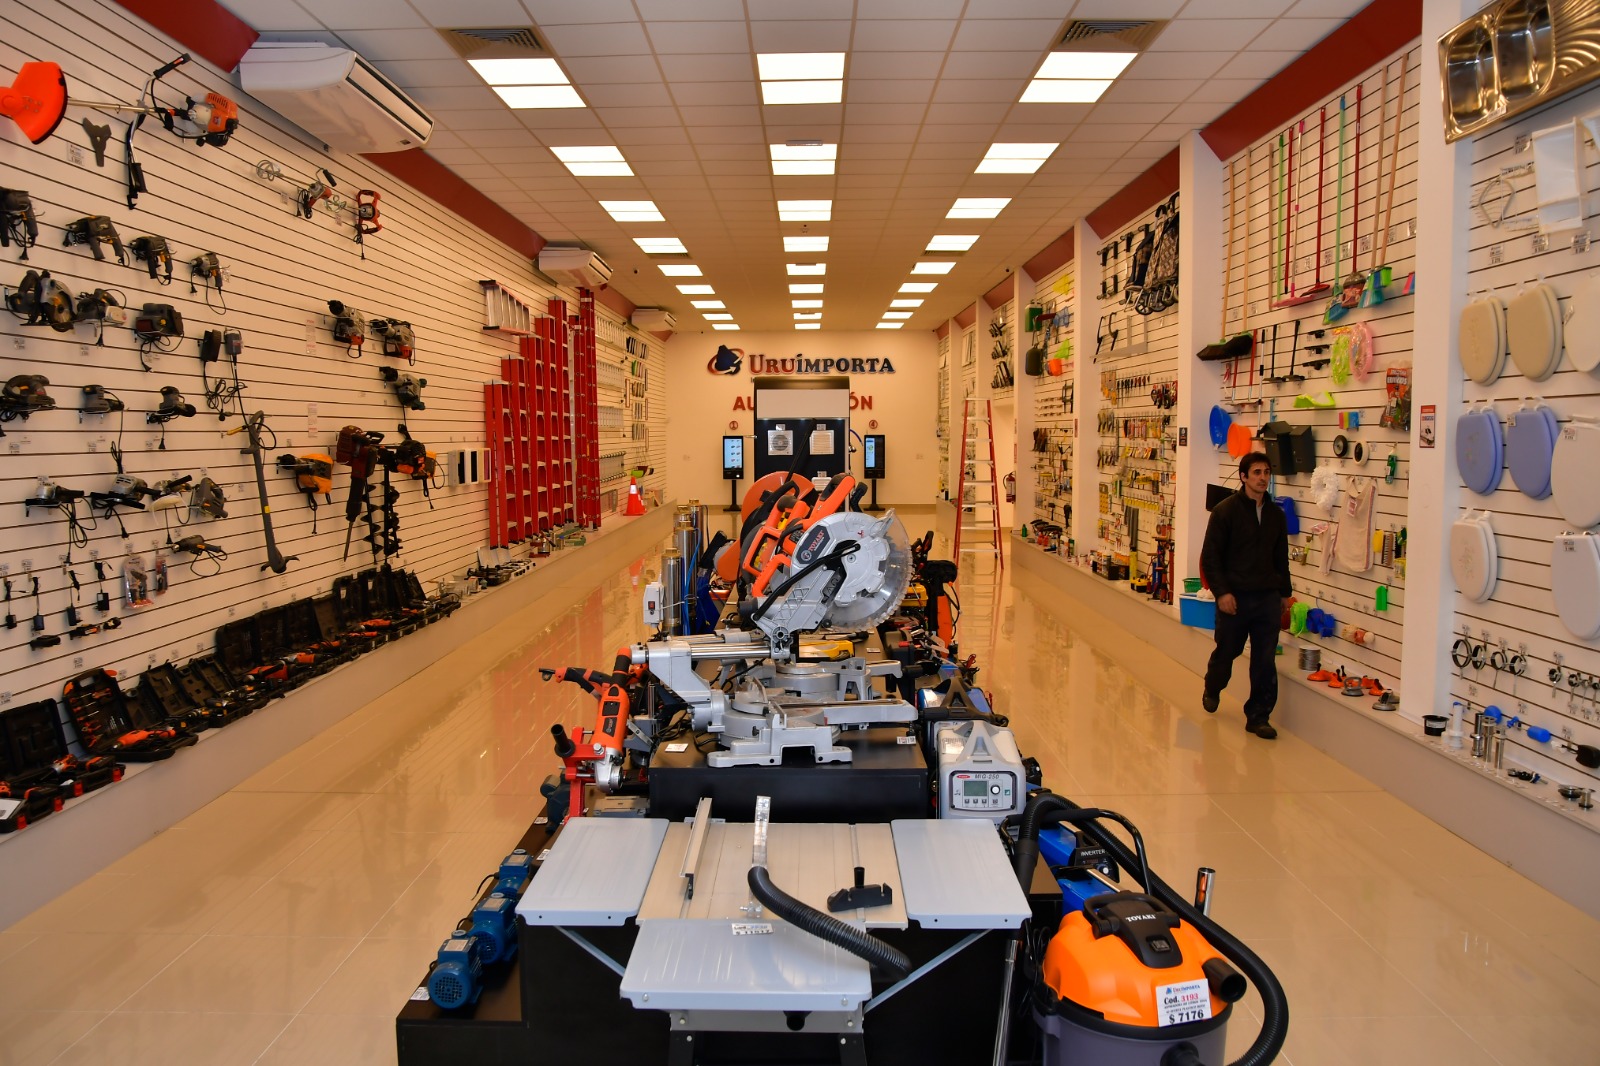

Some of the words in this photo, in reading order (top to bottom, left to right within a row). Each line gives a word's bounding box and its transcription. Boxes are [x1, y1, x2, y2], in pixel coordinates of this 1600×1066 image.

[1080, 849, 1106, 857] INVERTER
[1126, 914, 1157, 922] TOYAKI
[1164, 995, 1180, 1005] Cod.
[1180, 993, 1199, 1003] 3193
[1168, 1013, 1175, 1024] $
[1178, 1009, 1204, 1022] 7176
